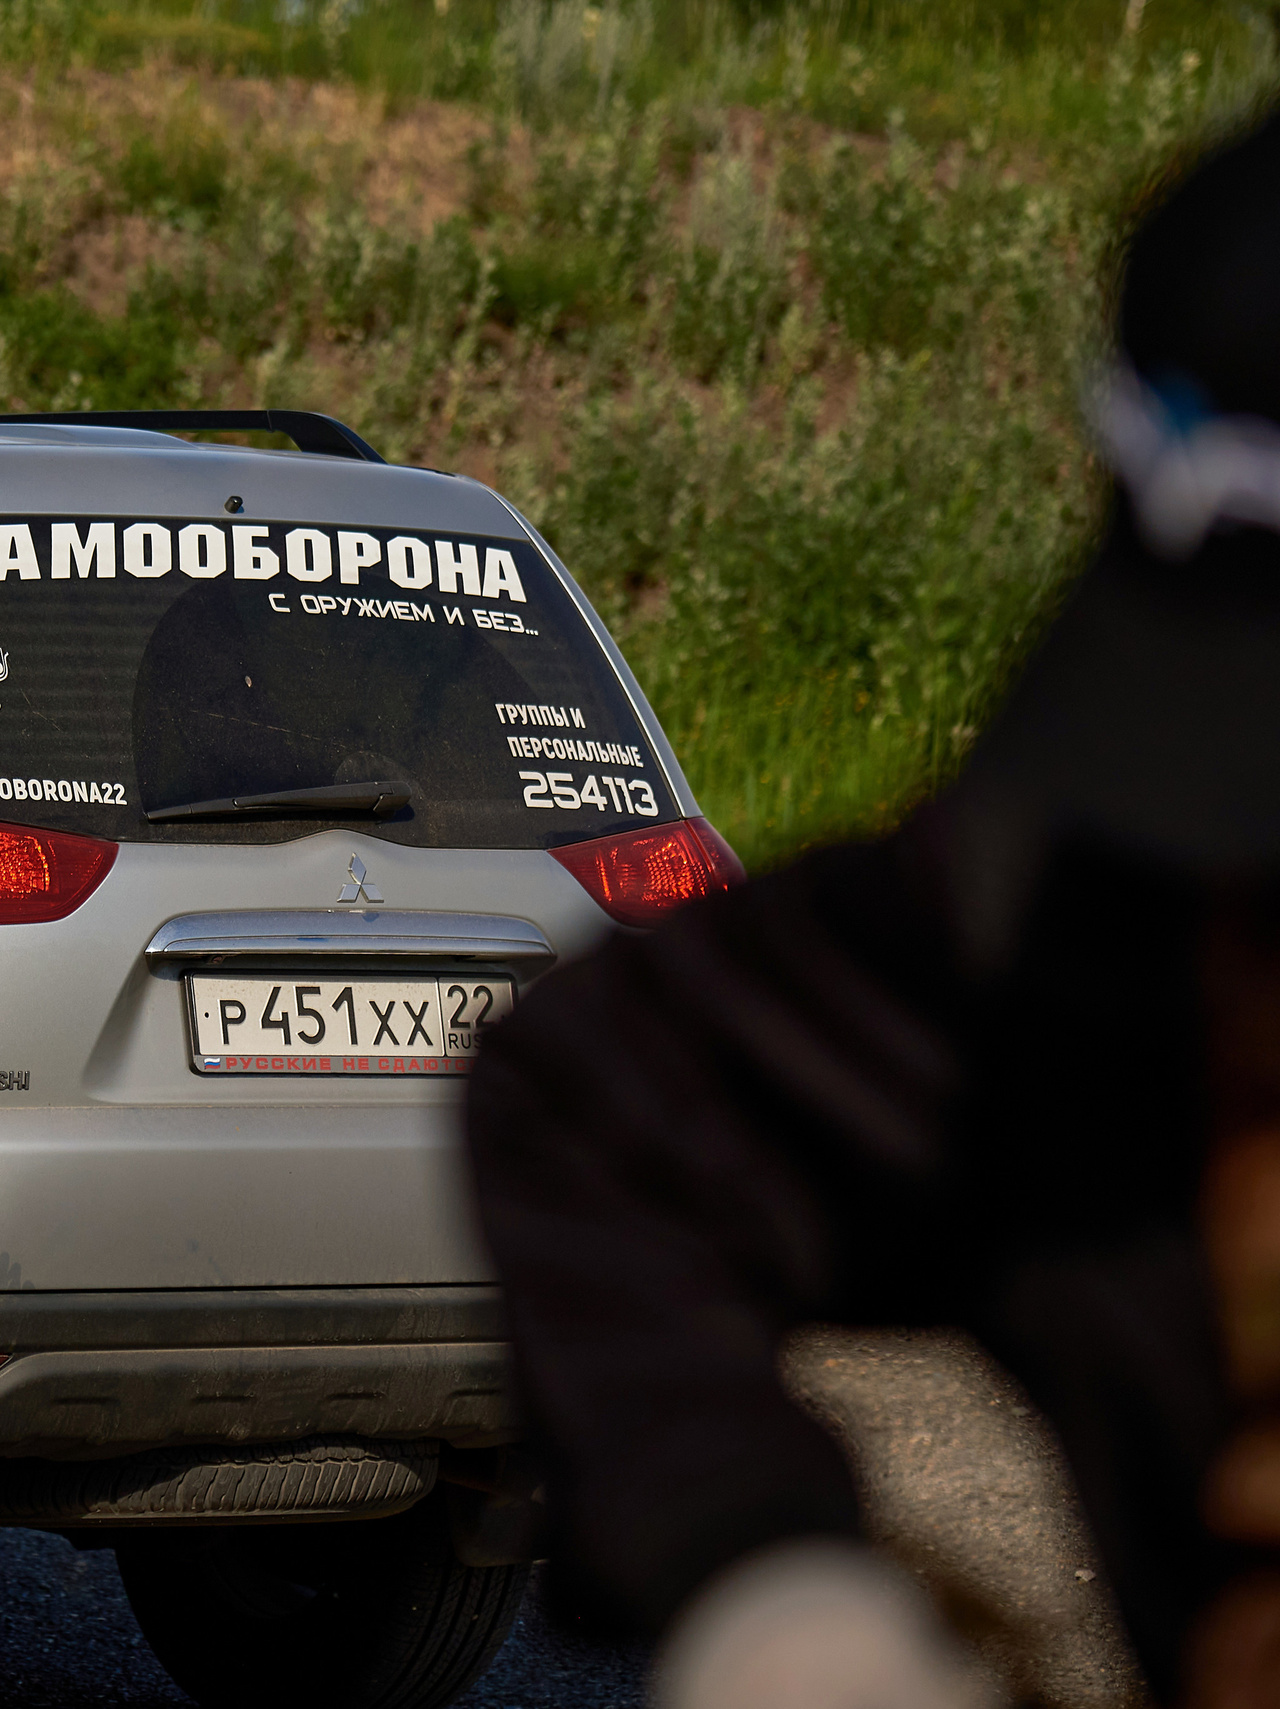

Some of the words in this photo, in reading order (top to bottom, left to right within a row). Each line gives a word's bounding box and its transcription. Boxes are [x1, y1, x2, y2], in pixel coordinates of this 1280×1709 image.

[269, 593, 291, 613] С
[300, 594, 436, 623] ОРУЖИЕМ
[443, 605, 465, 626] И
[472, 608, 539, 636] БЕЗ...
[495, 703, 570, 728] ГРУППЫ
[569, 707, 586, 729] И
[506, 736, 644, 768] ПЕРСОНАЛЬНЫЕ
[518, 770, 660, 818] 254113
[447, 984, 496, 1029] 22
[225, 1056, 331, 1071] РУССКИЕ
[342, 1057, 370, 1071] НЕ
[378, 1057, 476, 1073] СДАЮТС
